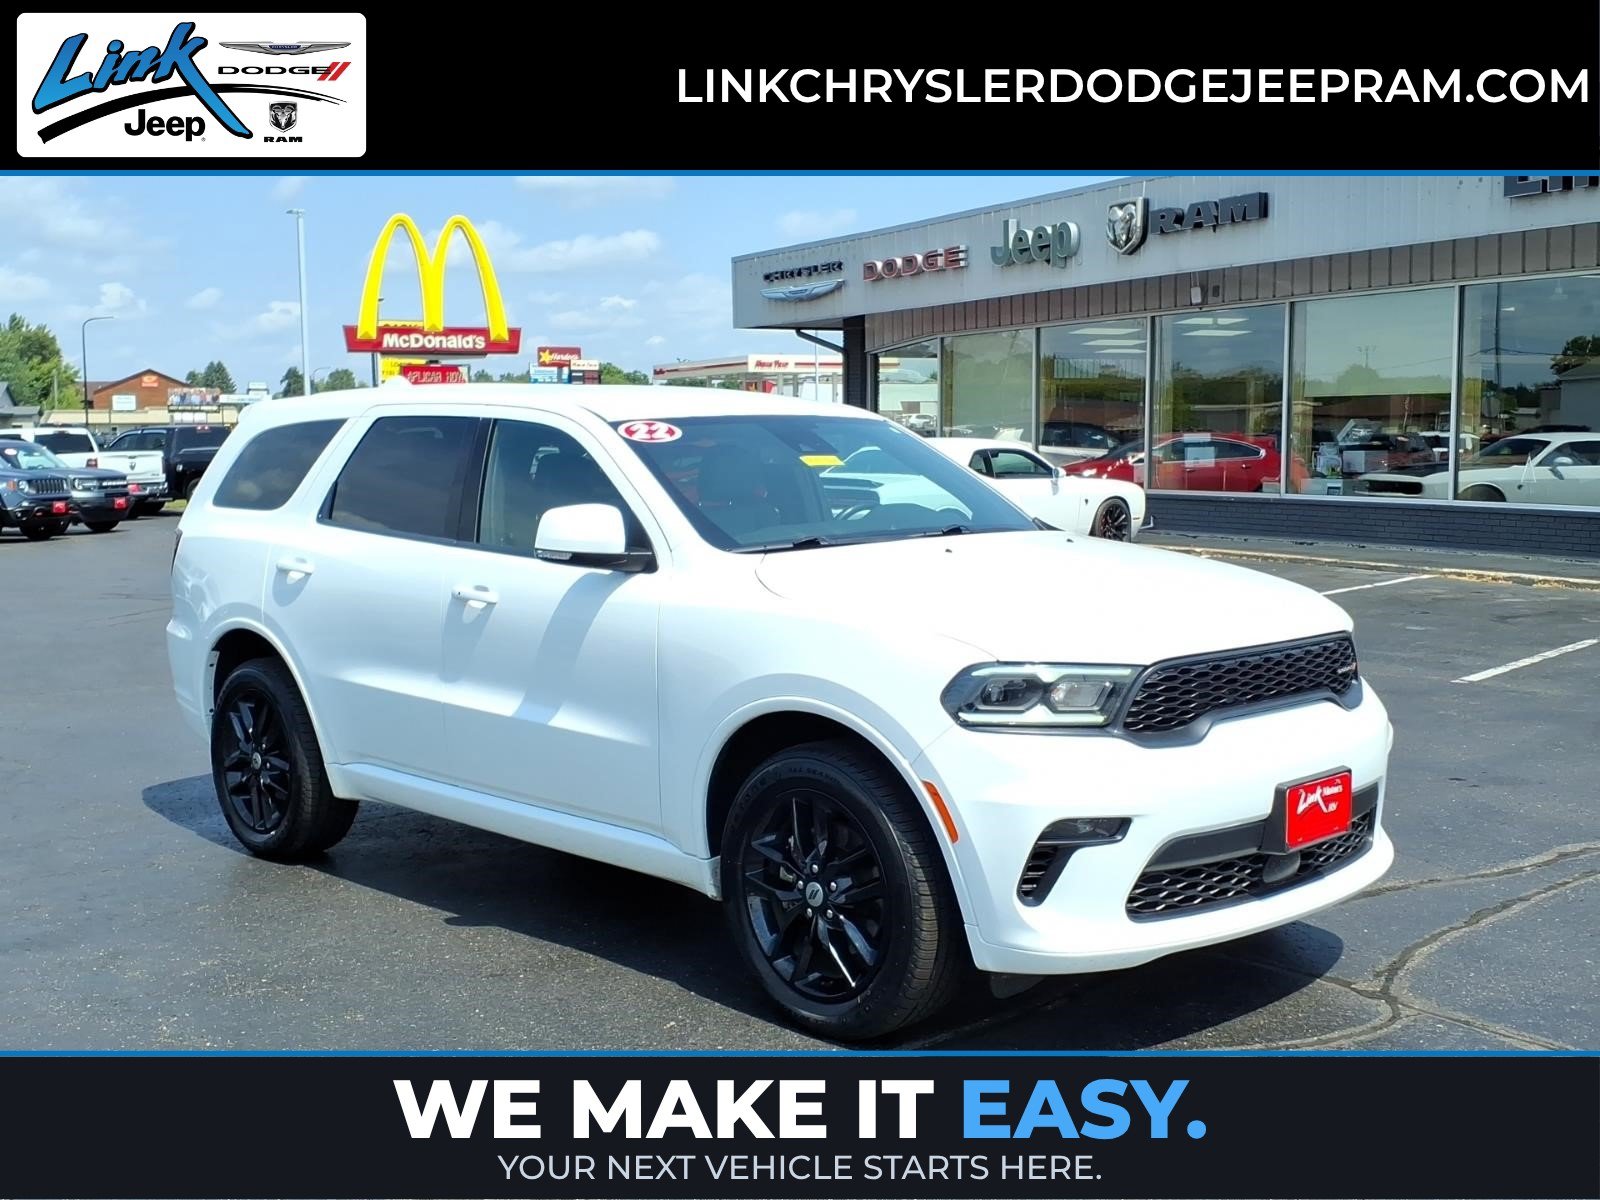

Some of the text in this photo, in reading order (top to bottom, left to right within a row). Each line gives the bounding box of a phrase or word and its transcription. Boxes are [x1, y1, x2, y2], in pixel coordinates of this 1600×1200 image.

[1151, 192, 1268, 235] RAM
[990, 218, 1080, 268] Jeep
[763, 260, 843, 282] CHRYSLER
[863, 245, 968, 281] DODGE
[382, 333, 486, 349] McDonald's
[629, 422, 672, 440] 22
